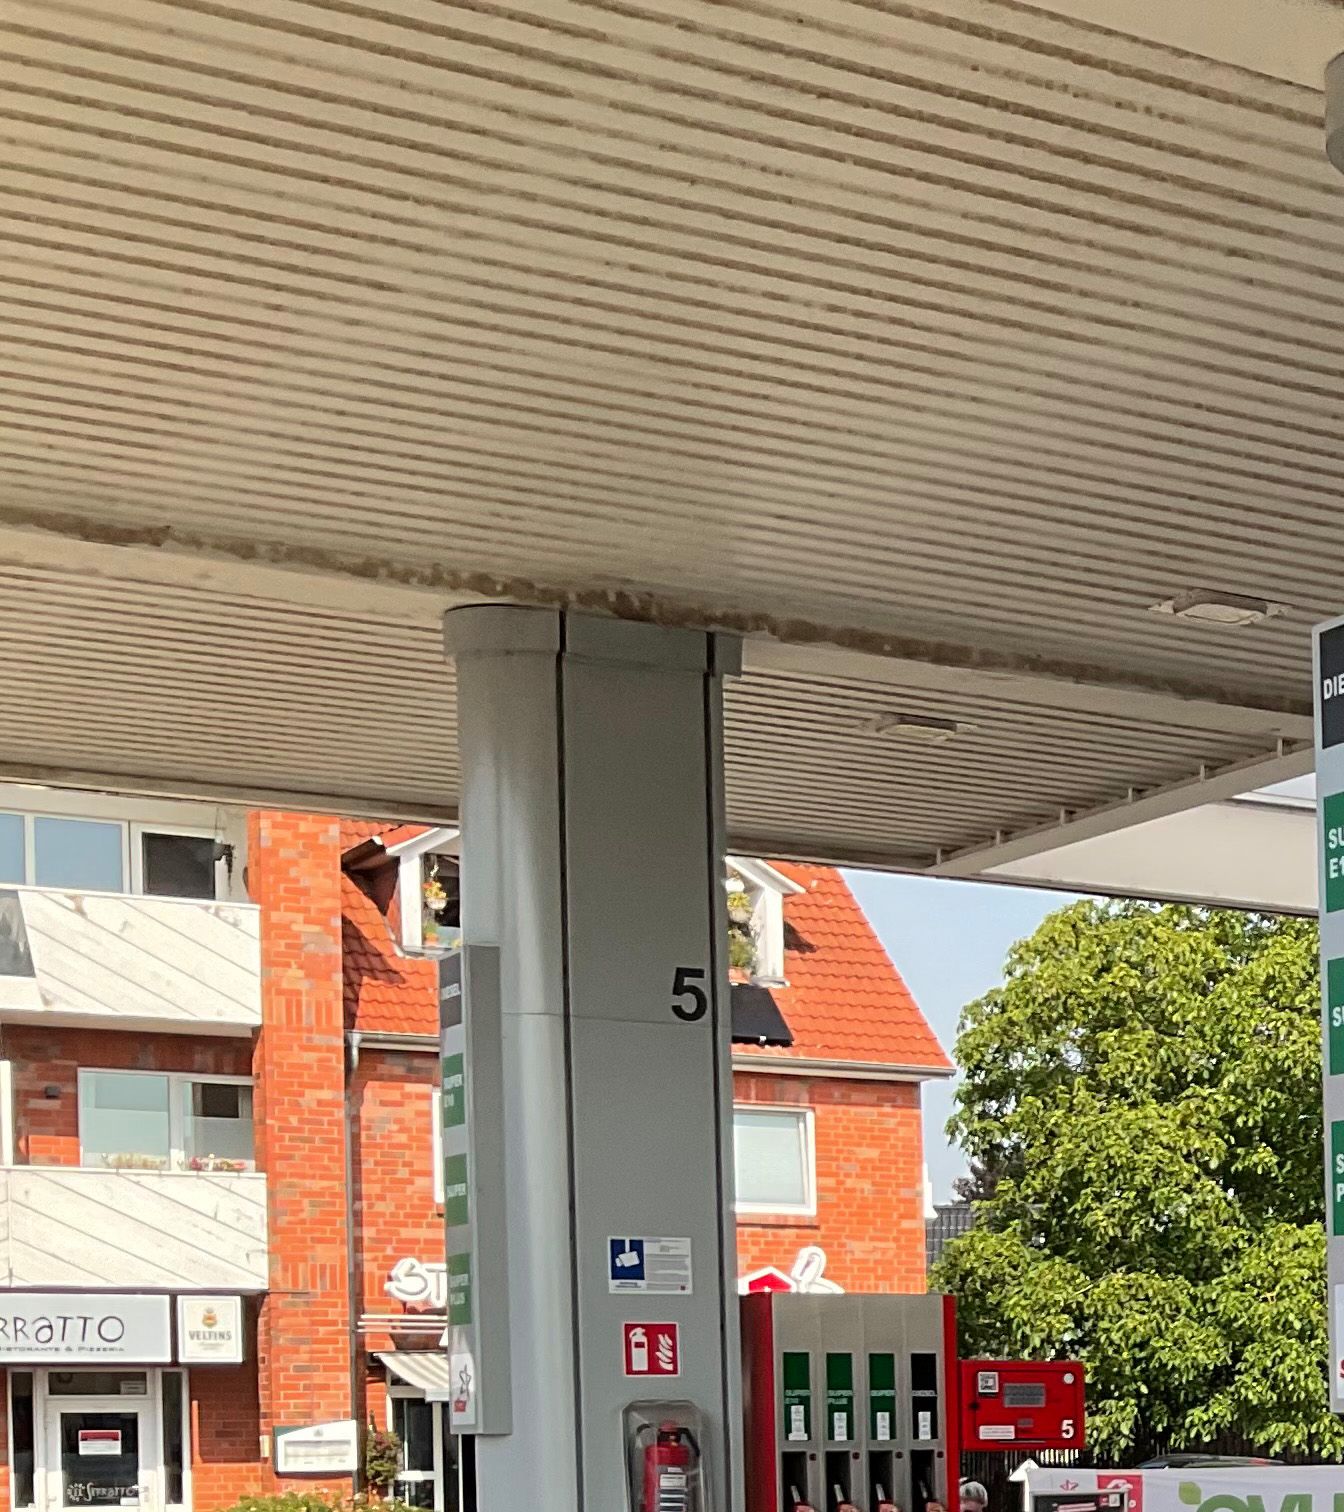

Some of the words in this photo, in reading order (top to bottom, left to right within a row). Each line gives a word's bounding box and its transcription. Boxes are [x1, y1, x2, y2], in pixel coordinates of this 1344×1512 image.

[672, 967, 707, 1021] 5
[189, 1330, 232, 1340] VELTINS
[1061, 1419, 1075, 1439] 5
